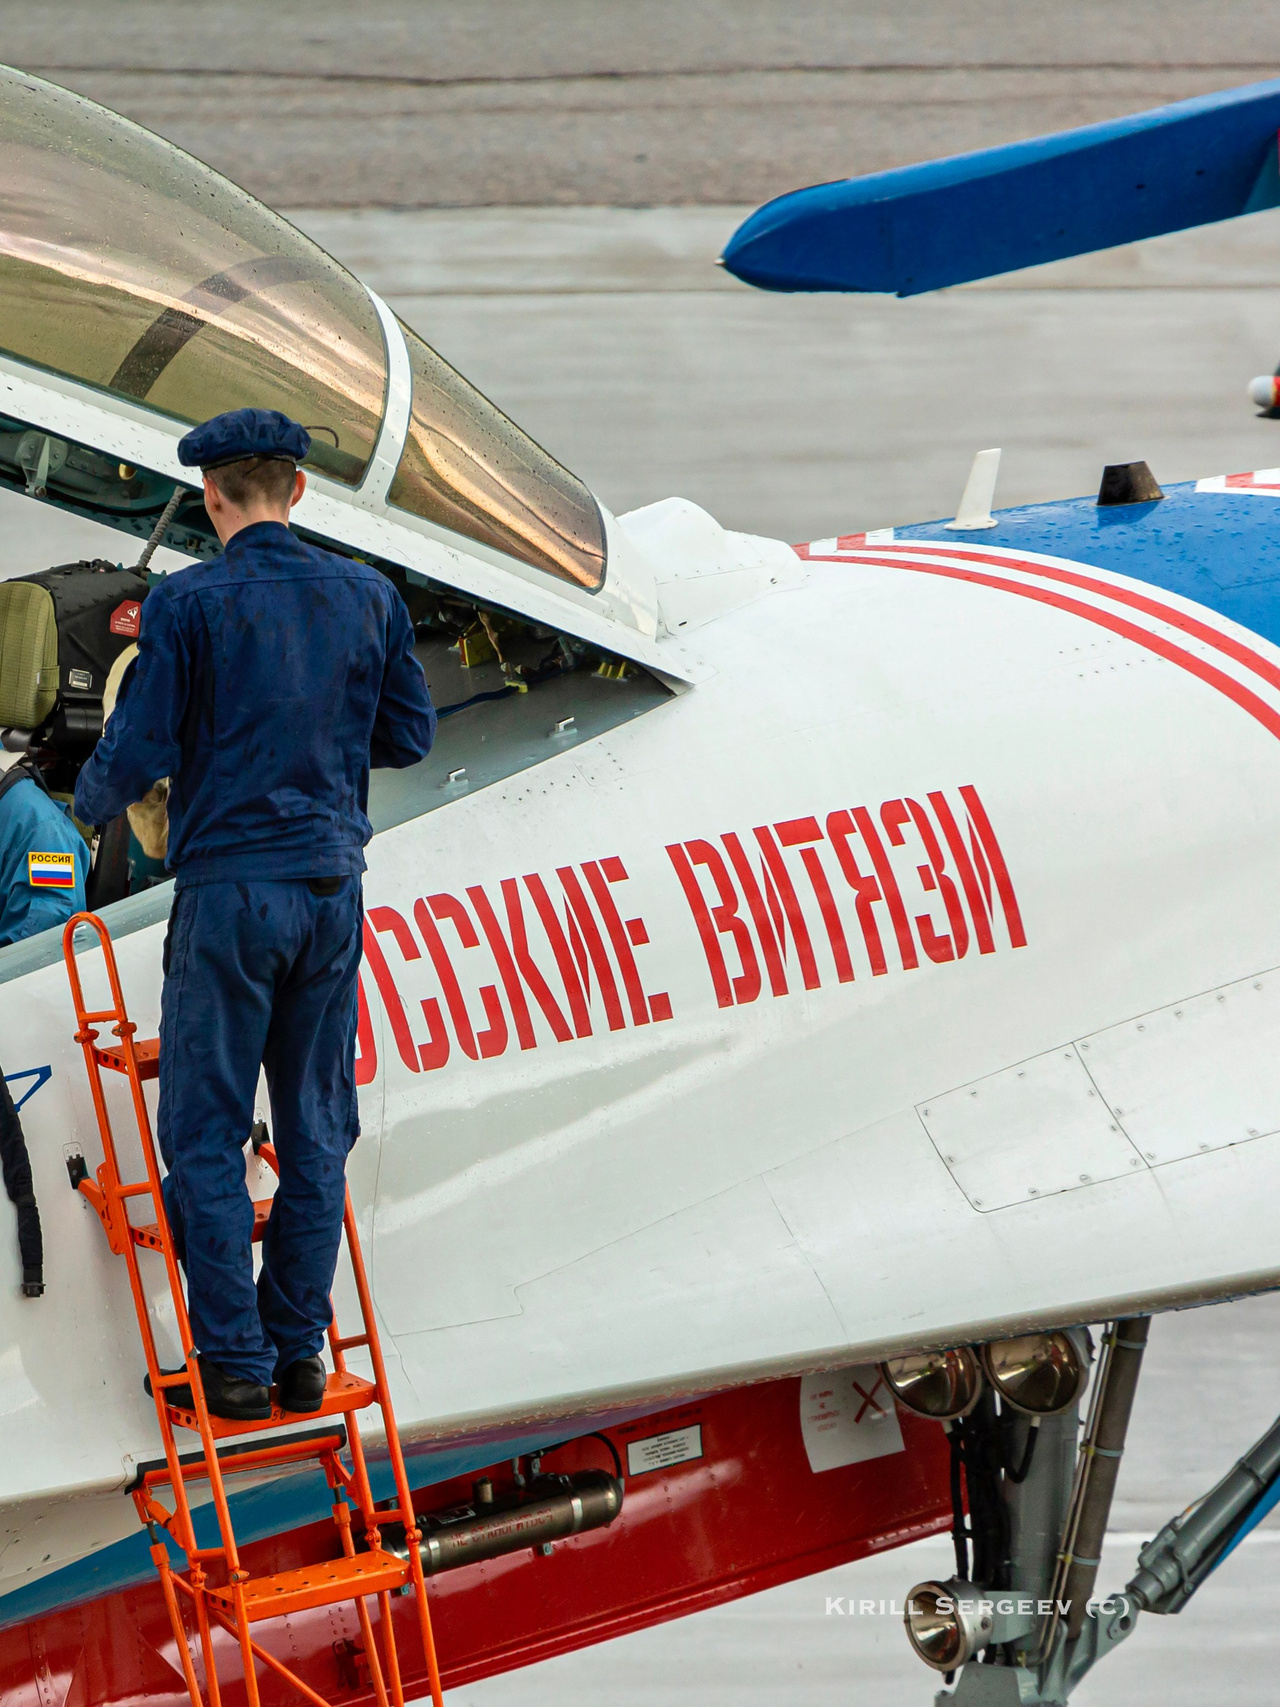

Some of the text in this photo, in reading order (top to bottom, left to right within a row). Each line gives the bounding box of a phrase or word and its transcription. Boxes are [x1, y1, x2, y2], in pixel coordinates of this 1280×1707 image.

[31, 854, 71, 863] РОССИЯ
[355, 784, 1028, 1086] ССКИЕ ВИТЯЗИ
